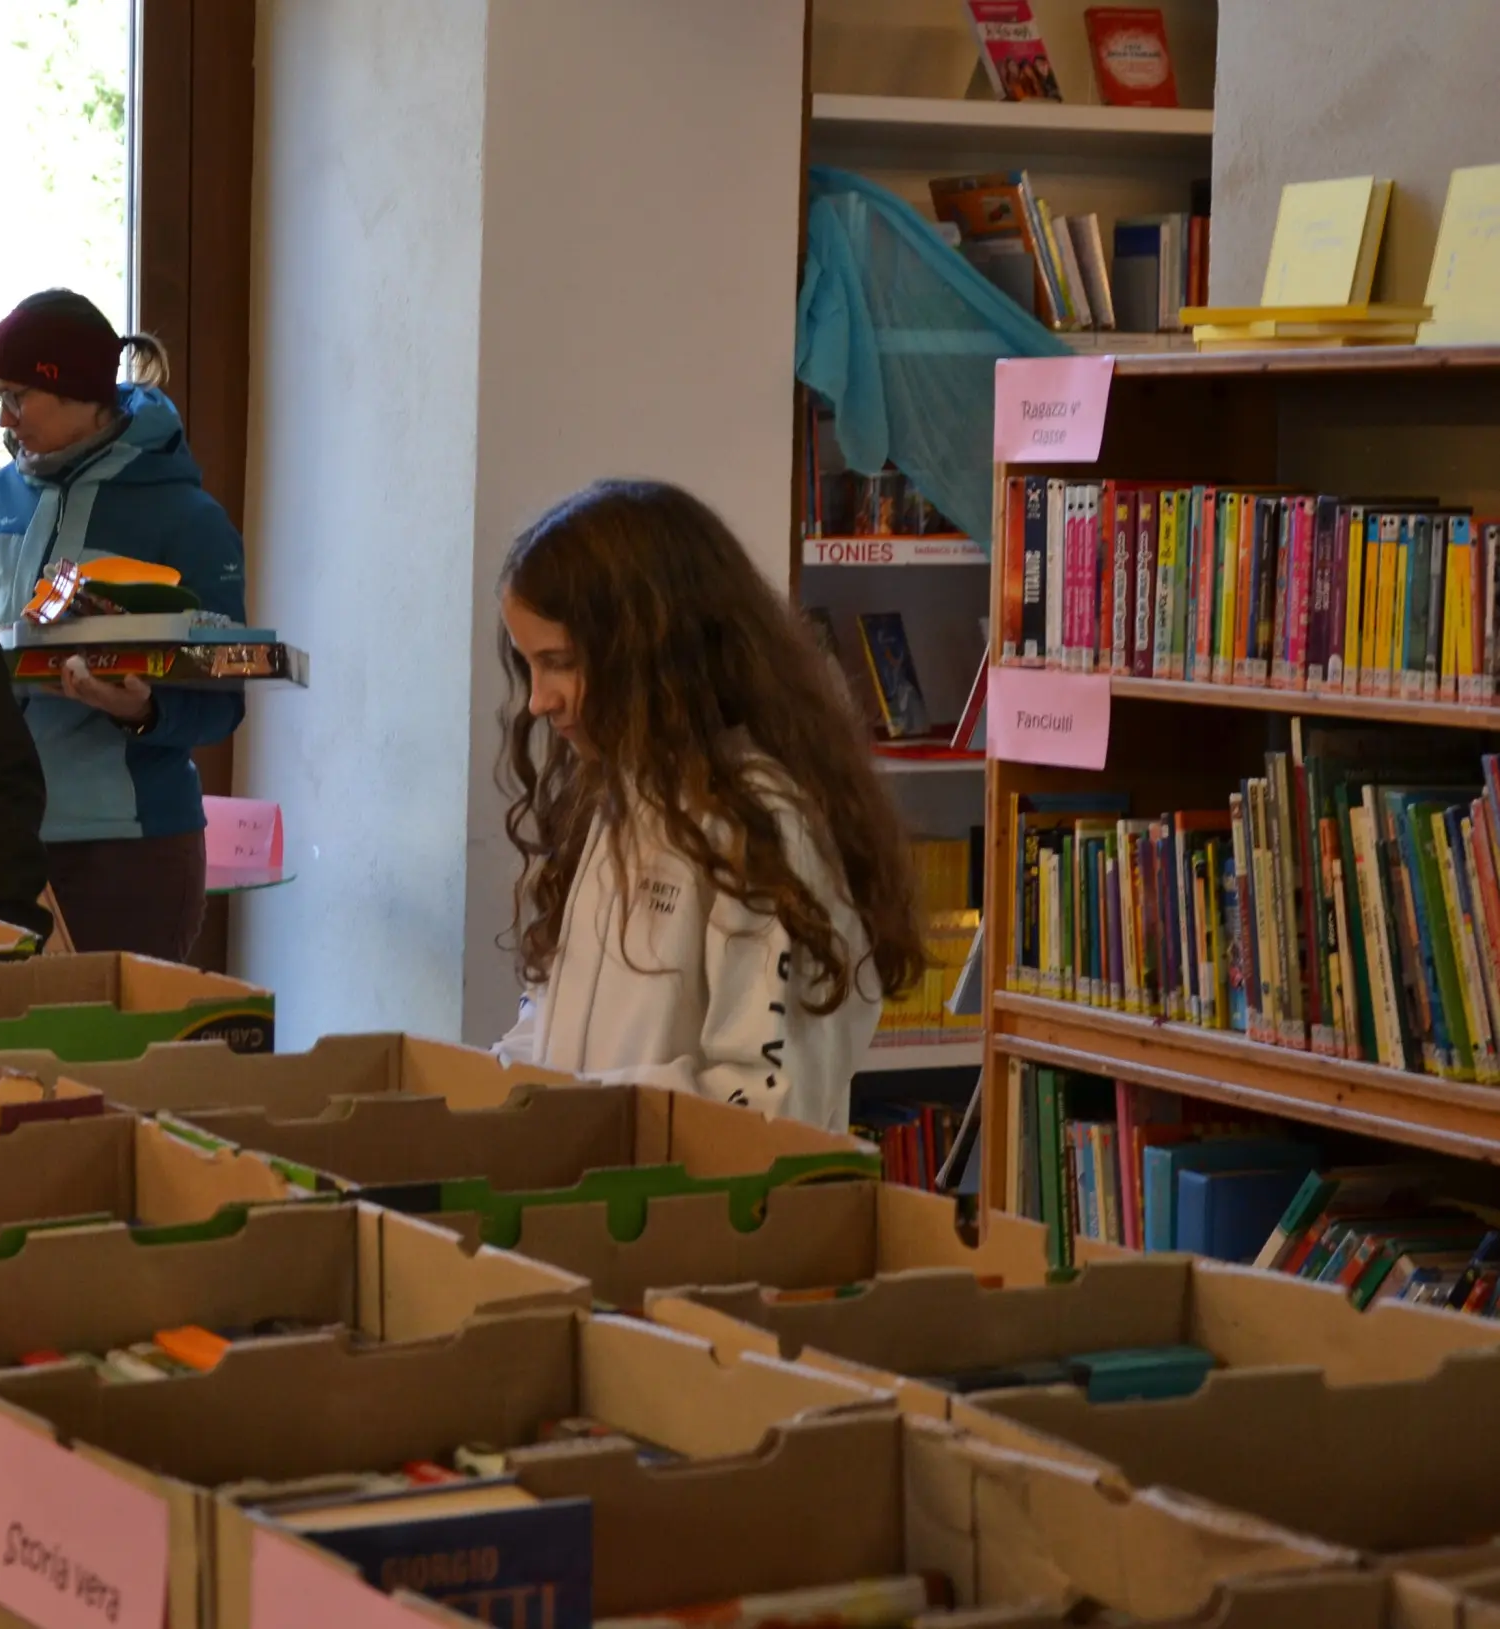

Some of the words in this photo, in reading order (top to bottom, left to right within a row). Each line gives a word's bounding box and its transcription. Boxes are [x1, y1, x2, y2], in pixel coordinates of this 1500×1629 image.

[1021, 400, 1067, 420] Ragazzi
[814, 542, 894, 564] TONIES
[1016, 711, 1074, 734] Fanciulli
[3, 1521, 69, 1592] Storia
[75, 1564, 120, 1624] vera
